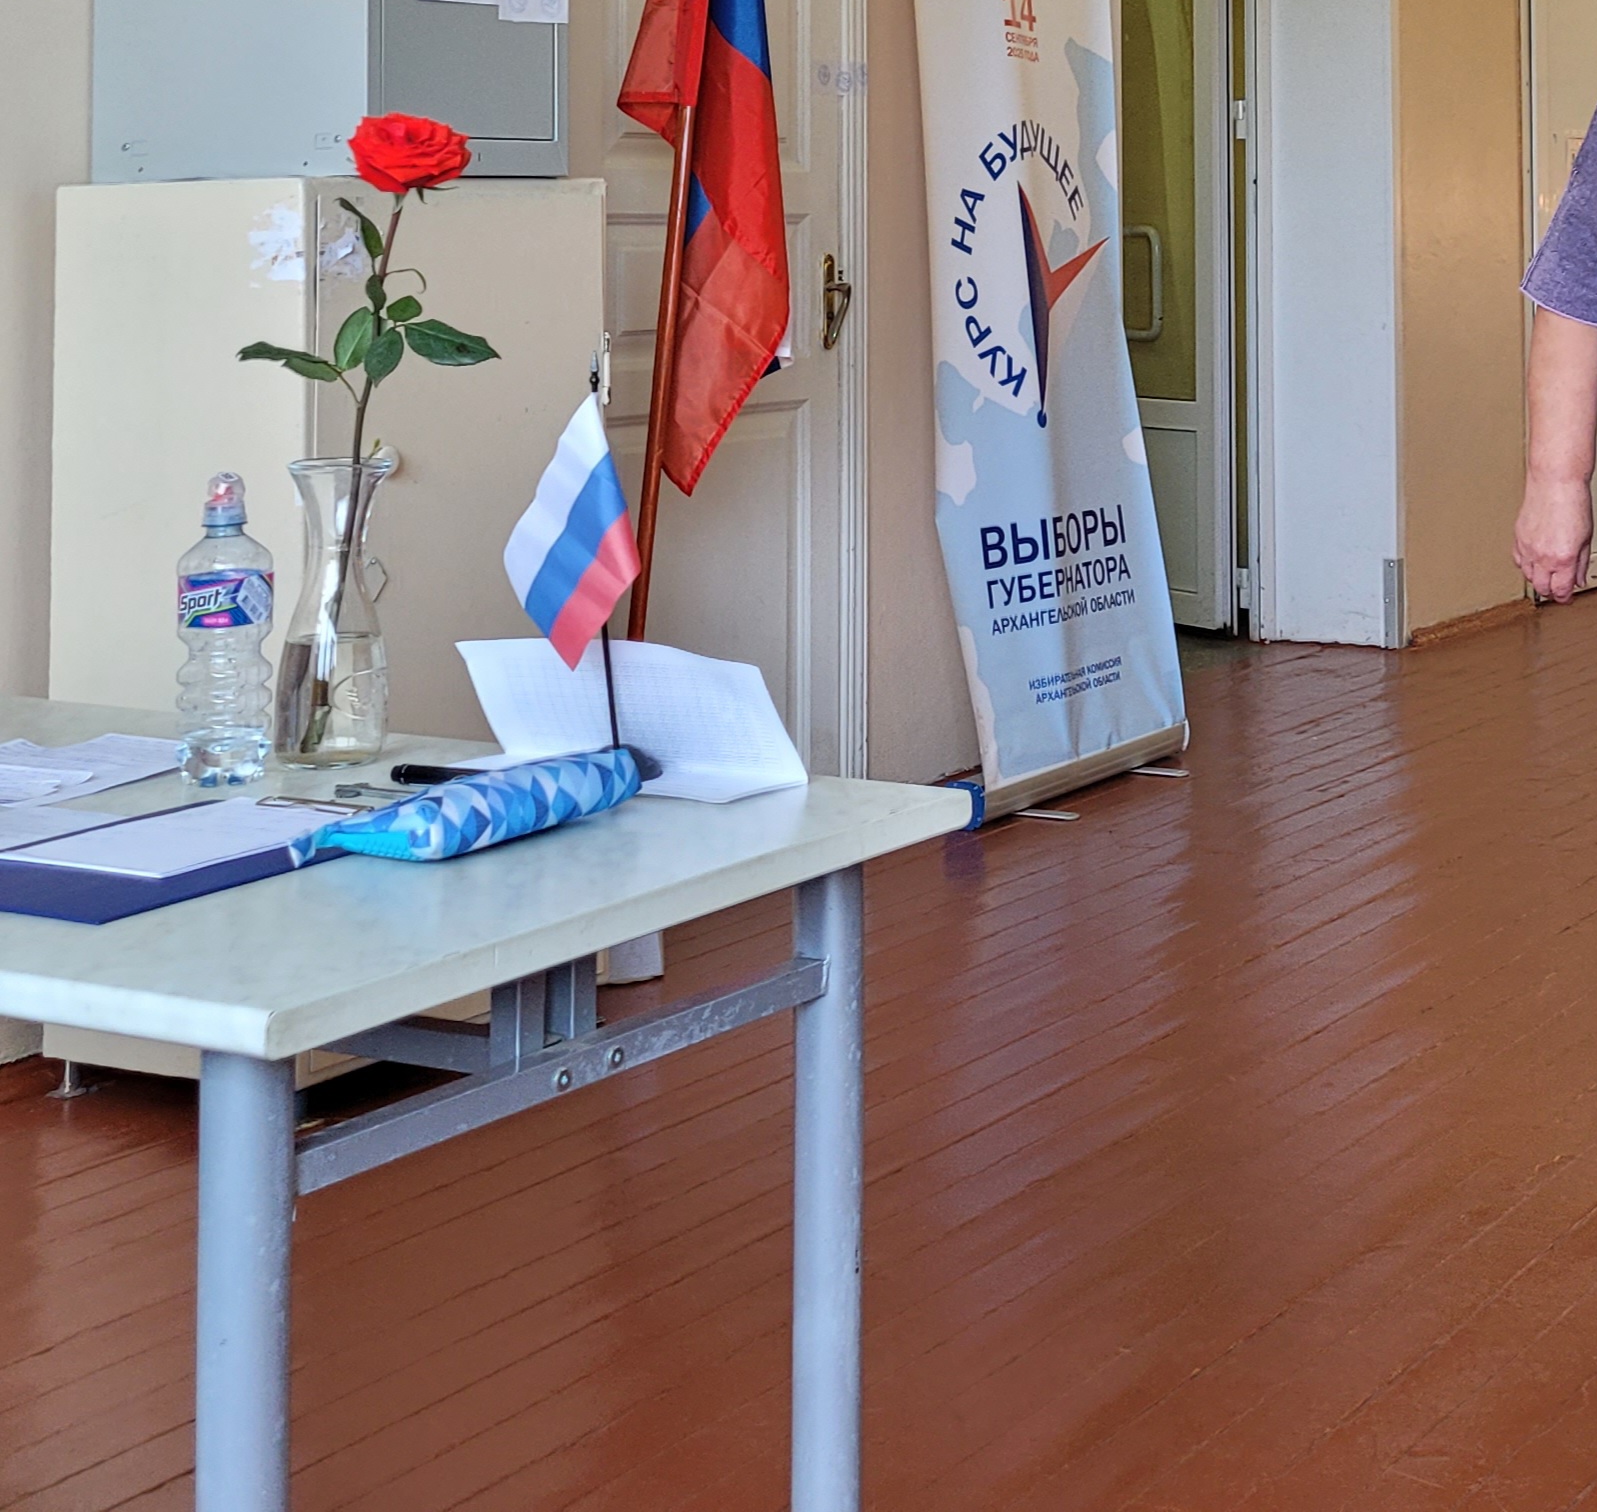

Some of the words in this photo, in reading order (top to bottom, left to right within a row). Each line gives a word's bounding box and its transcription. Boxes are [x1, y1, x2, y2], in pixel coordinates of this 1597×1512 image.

[979, 119, 1084, 221] БУДУЩЕЕ
[951, 188, 985, 255] НА
[955, 276, 1028, 398] КУРС
[980, 505, 1126, 570] ВЫБОРЫ
[180, 589, 223, 615] Sport
[986, 554, 1132, 610] ГУБЕРНАТОРА
[992, 596, 1089, 636] АРХАНГЕЛЬСКОЙ
[1090, 588, 1136, 614] ОБЛАСТИ
